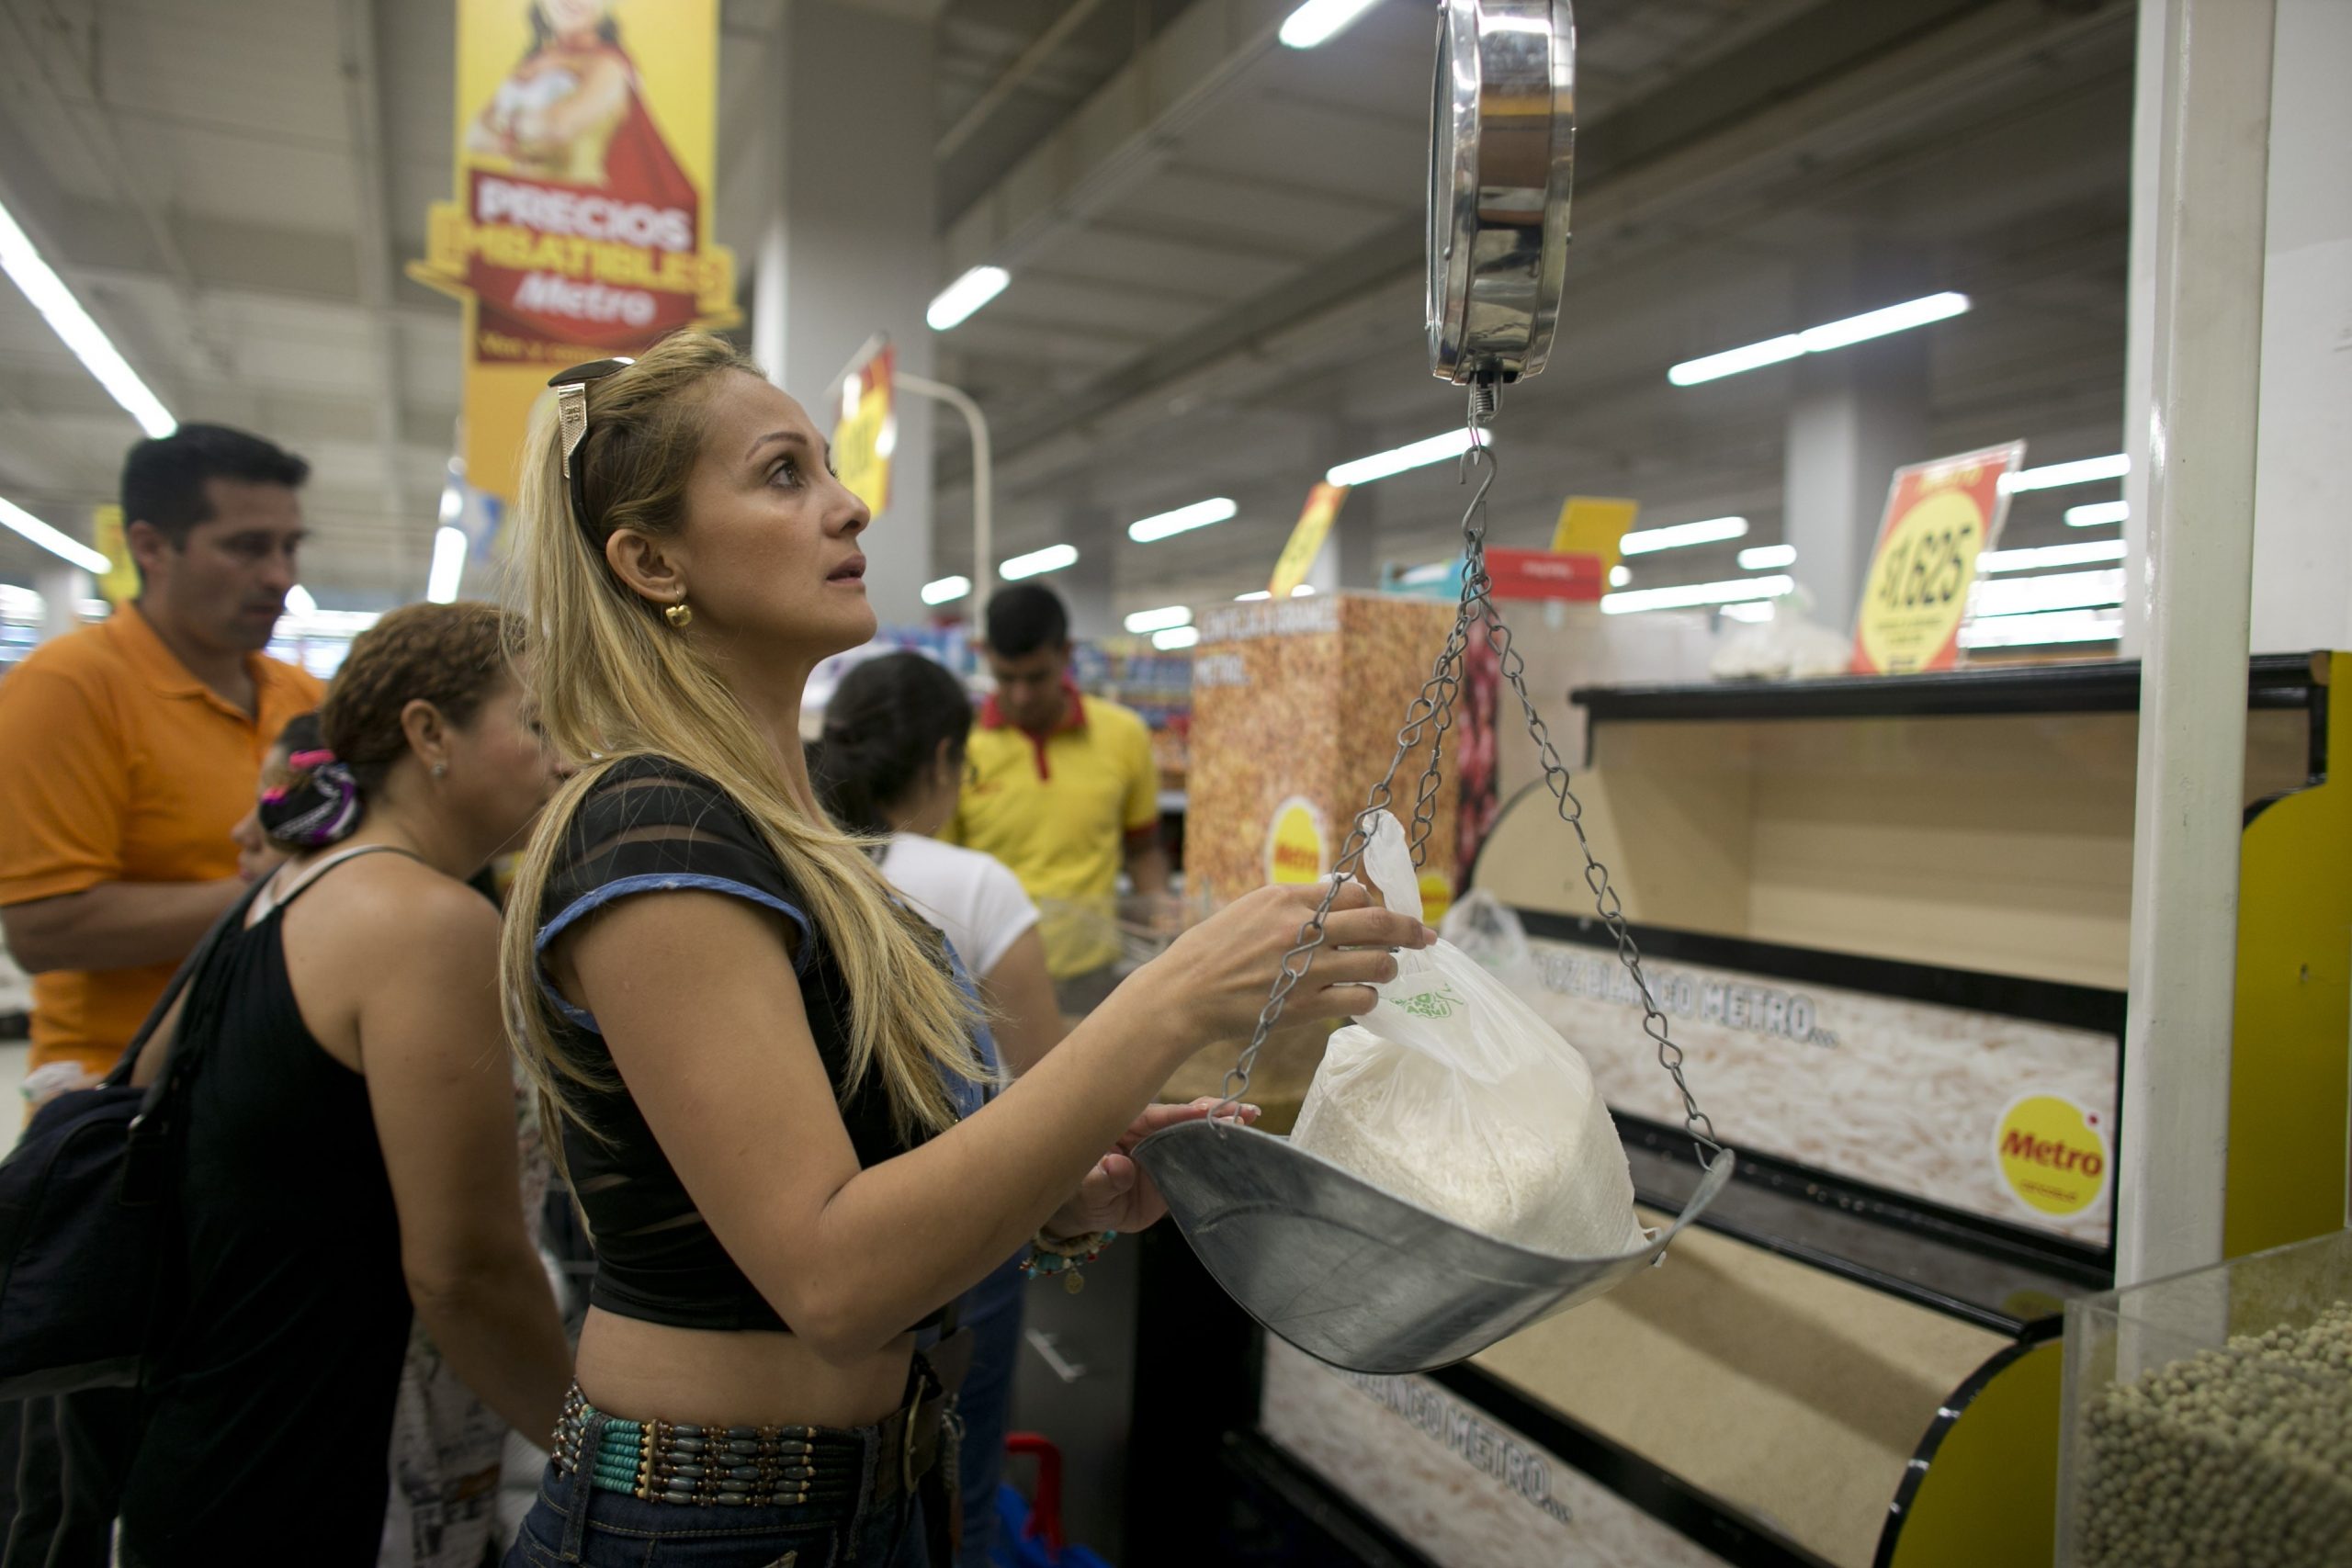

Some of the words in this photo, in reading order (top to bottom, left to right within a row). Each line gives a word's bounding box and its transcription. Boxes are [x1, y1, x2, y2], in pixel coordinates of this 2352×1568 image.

[475, 177, 693, 253] PRECIOS
[512, 271, 656, 326] Metro
[2000, 1127, 2103, 1179] Metro
